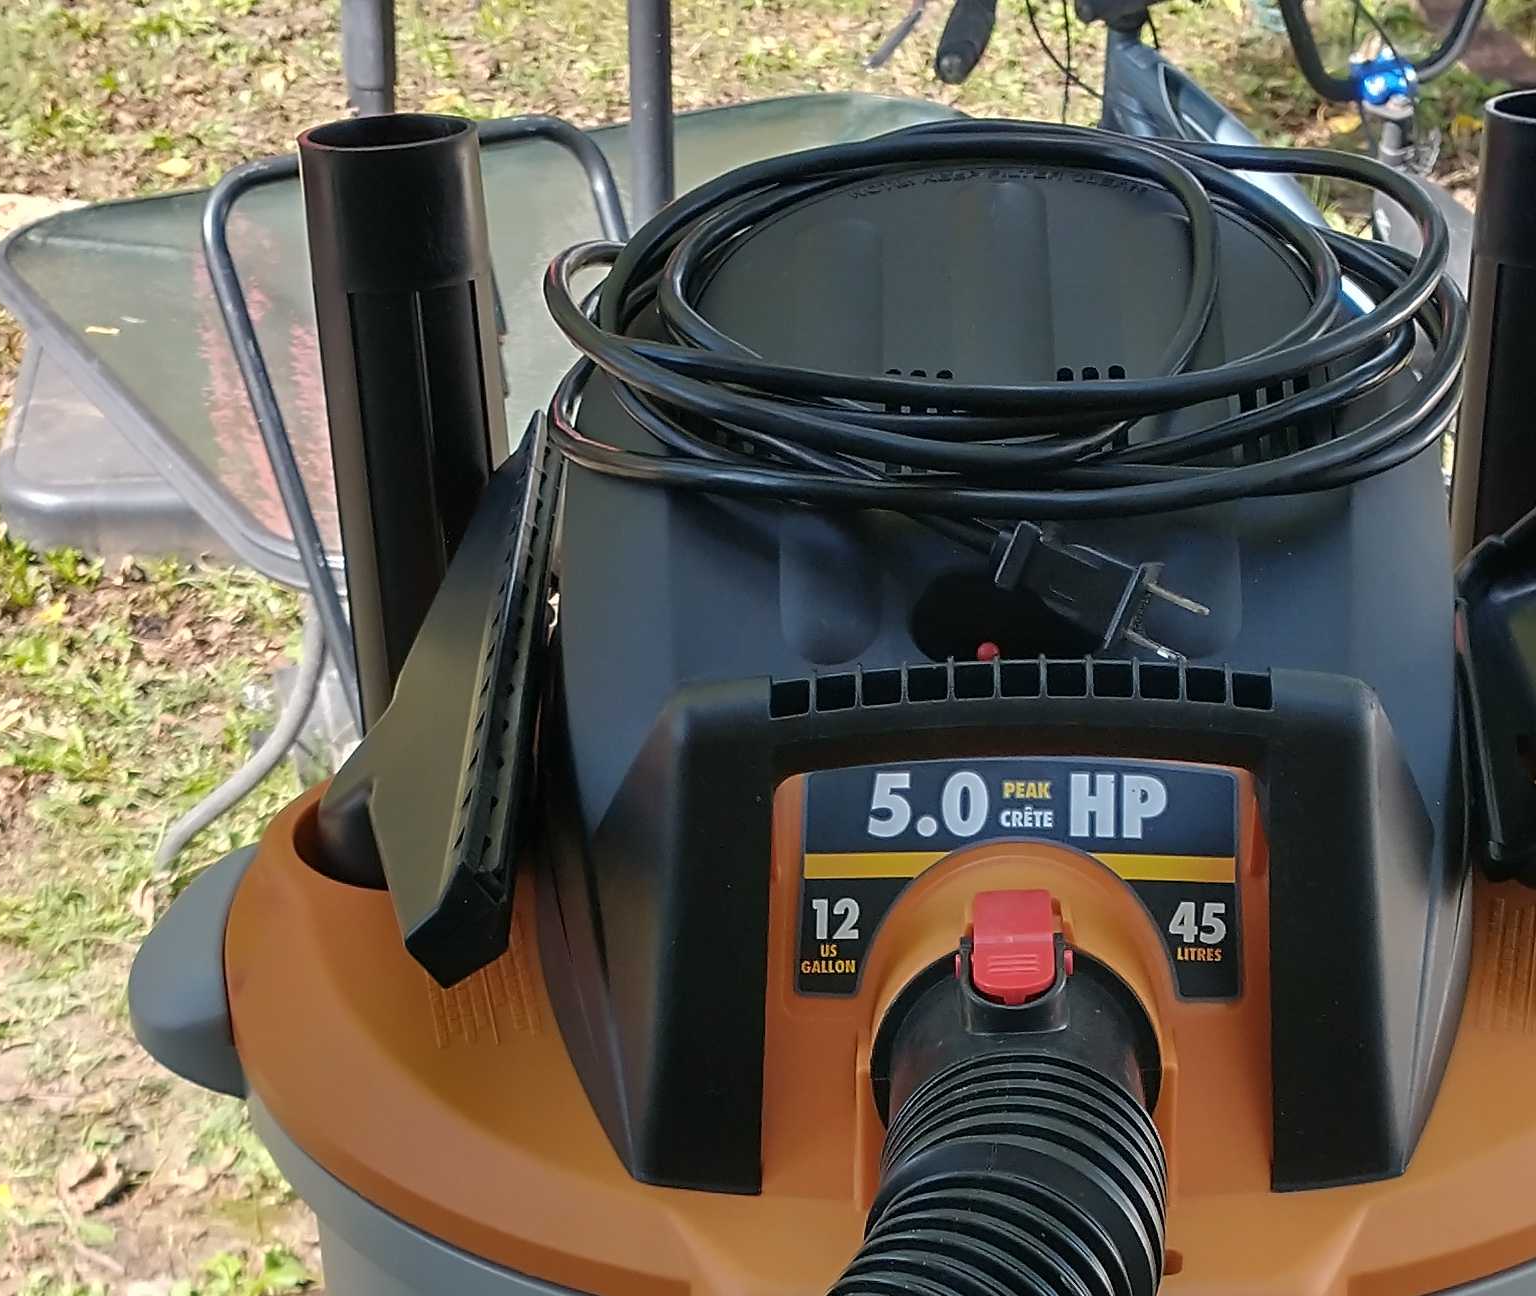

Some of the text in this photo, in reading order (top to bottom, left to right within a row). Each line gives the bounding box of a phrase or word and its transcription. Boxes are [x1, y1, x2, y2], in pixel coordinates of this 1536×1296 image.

[1002, 779, 1052, 800] PEAK
[867, 771, 1167, 840] 5.0 HP
[999, 806, 1054, 829] CRÊTE
[811, 897, 860, 941] 12
[1168, 901, 1227, 945] 45
[819, 943, 839, 959] US
[1176, 946, 1223, 962] LITRES
[801, 958, 857, 975] GALLON
